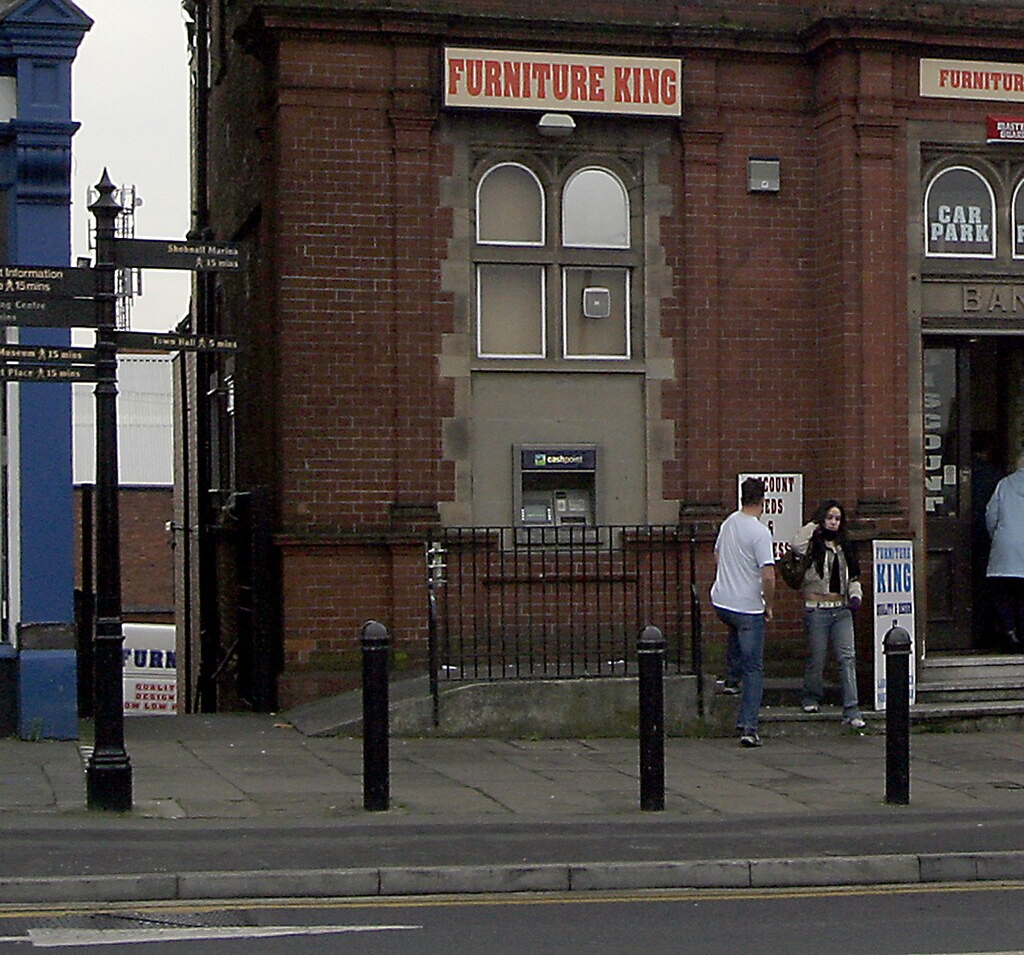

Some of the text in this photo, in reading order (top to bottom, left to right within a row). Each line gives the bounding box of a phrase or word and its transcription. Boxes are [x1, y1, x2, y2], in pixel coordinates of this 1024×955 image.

[448, 58, 676, 105] FURNITURE KING
[939, 205, 981, 224] CAR
[931, 223, 989, 242] PARK
[5, 268, 63, 278] Information
[15, 281, 26, 291] 15
[26, 282, 50, 291] mins
[48, 350, 59, 358] 15
[8, 369, 33, 377] Place
[877, 563, 911, 593] KING
